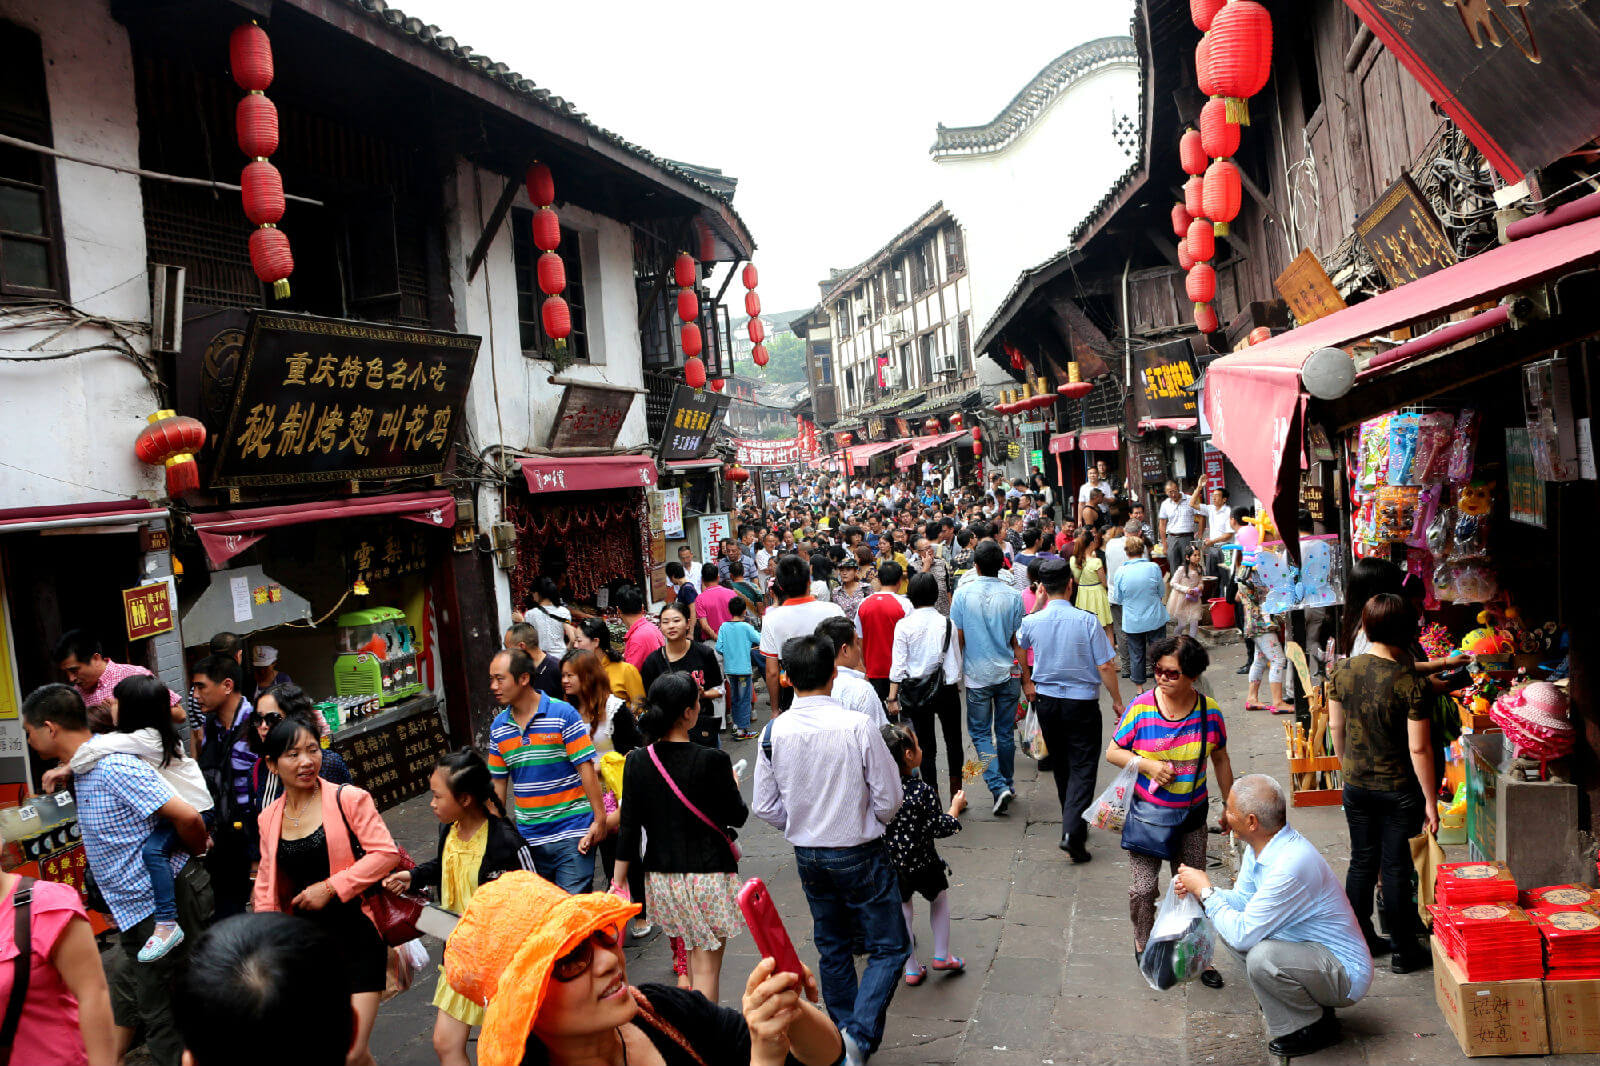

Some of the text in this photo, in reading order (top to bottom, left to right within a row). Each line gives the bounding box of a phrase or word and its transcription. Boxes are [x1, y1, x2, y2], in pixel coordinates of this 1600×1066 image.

[283, 352, 447, 391] 重庆特色名小吃
[237, 402, 452, 459] 秘制烤翅叫花鸡
